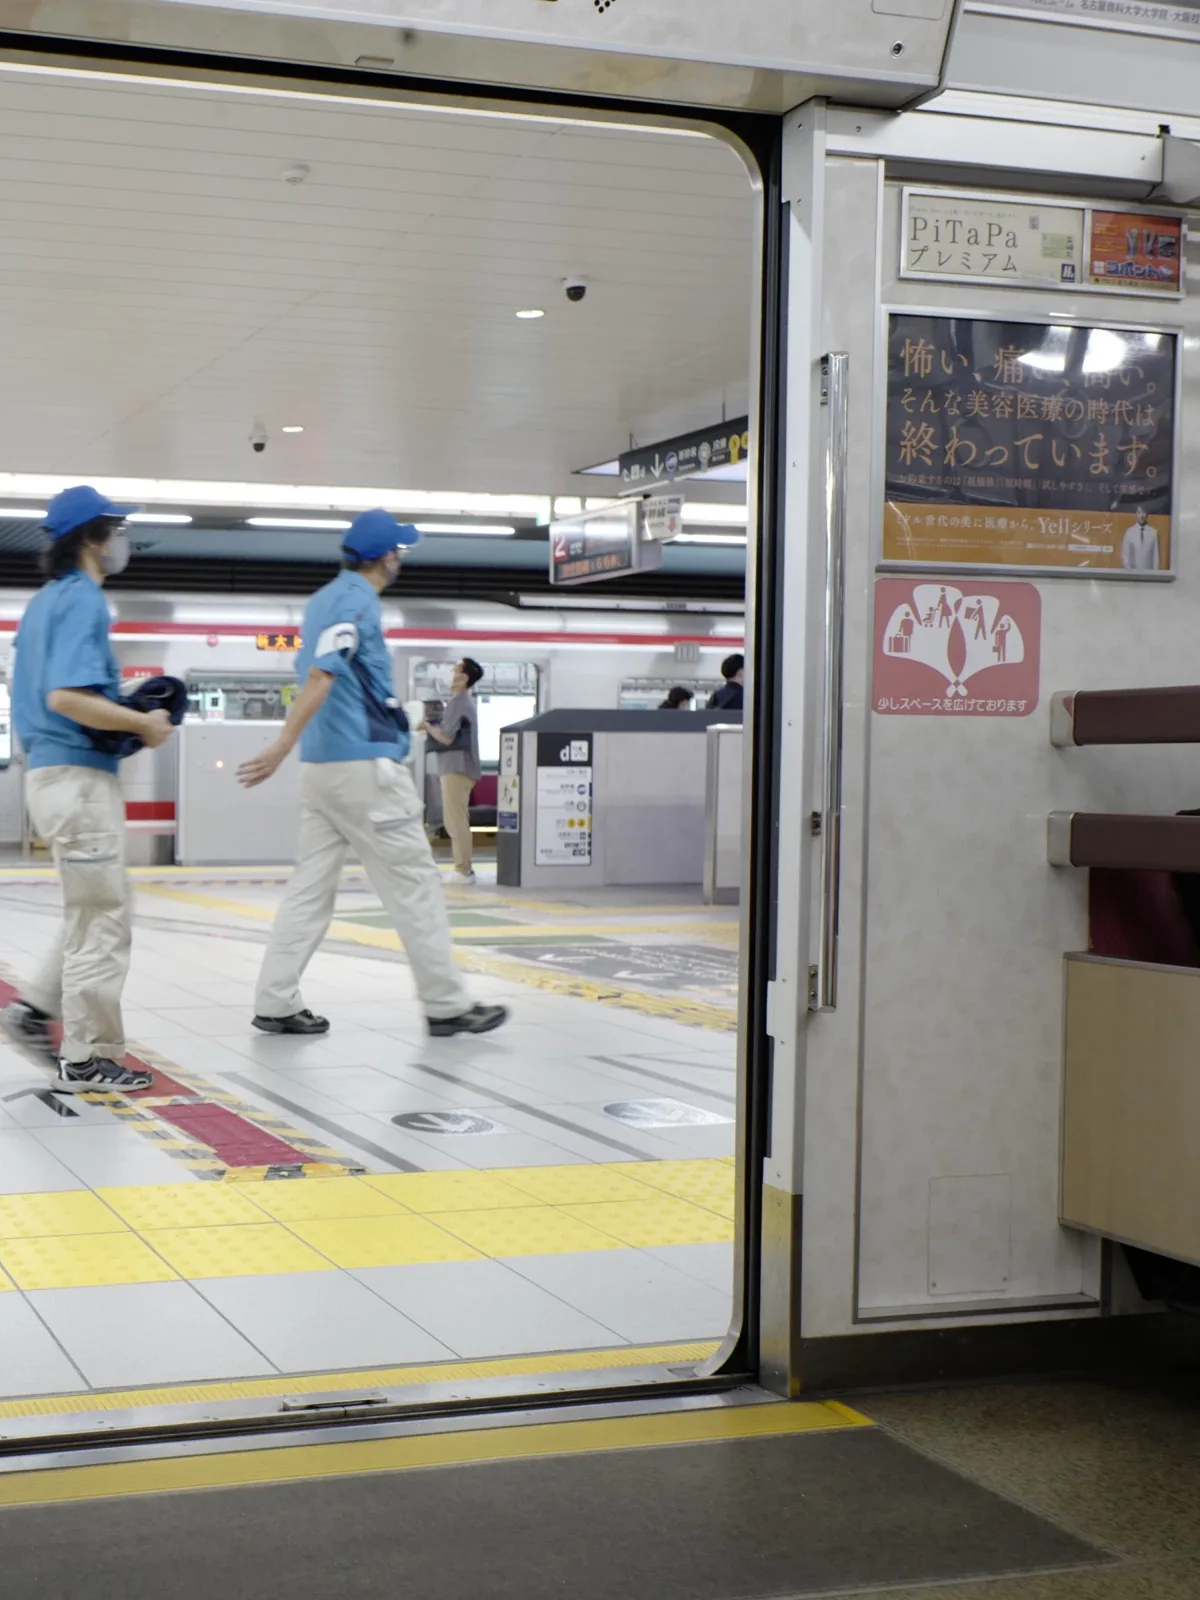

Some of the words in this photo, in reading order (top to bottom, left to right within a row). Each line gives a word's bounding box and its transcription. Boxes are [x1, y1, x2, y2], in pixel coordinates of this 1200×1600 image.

[910, 216, 1018, 249] PiTaPa
[910, 245, 1018, 272] プレミアム
[900, 387, 1155, 427] そんな美容医療の時代は
[900, 420, 1157, 478] 終わっています。
[877, 697, 1028, 712] 少しスペースを広げております
